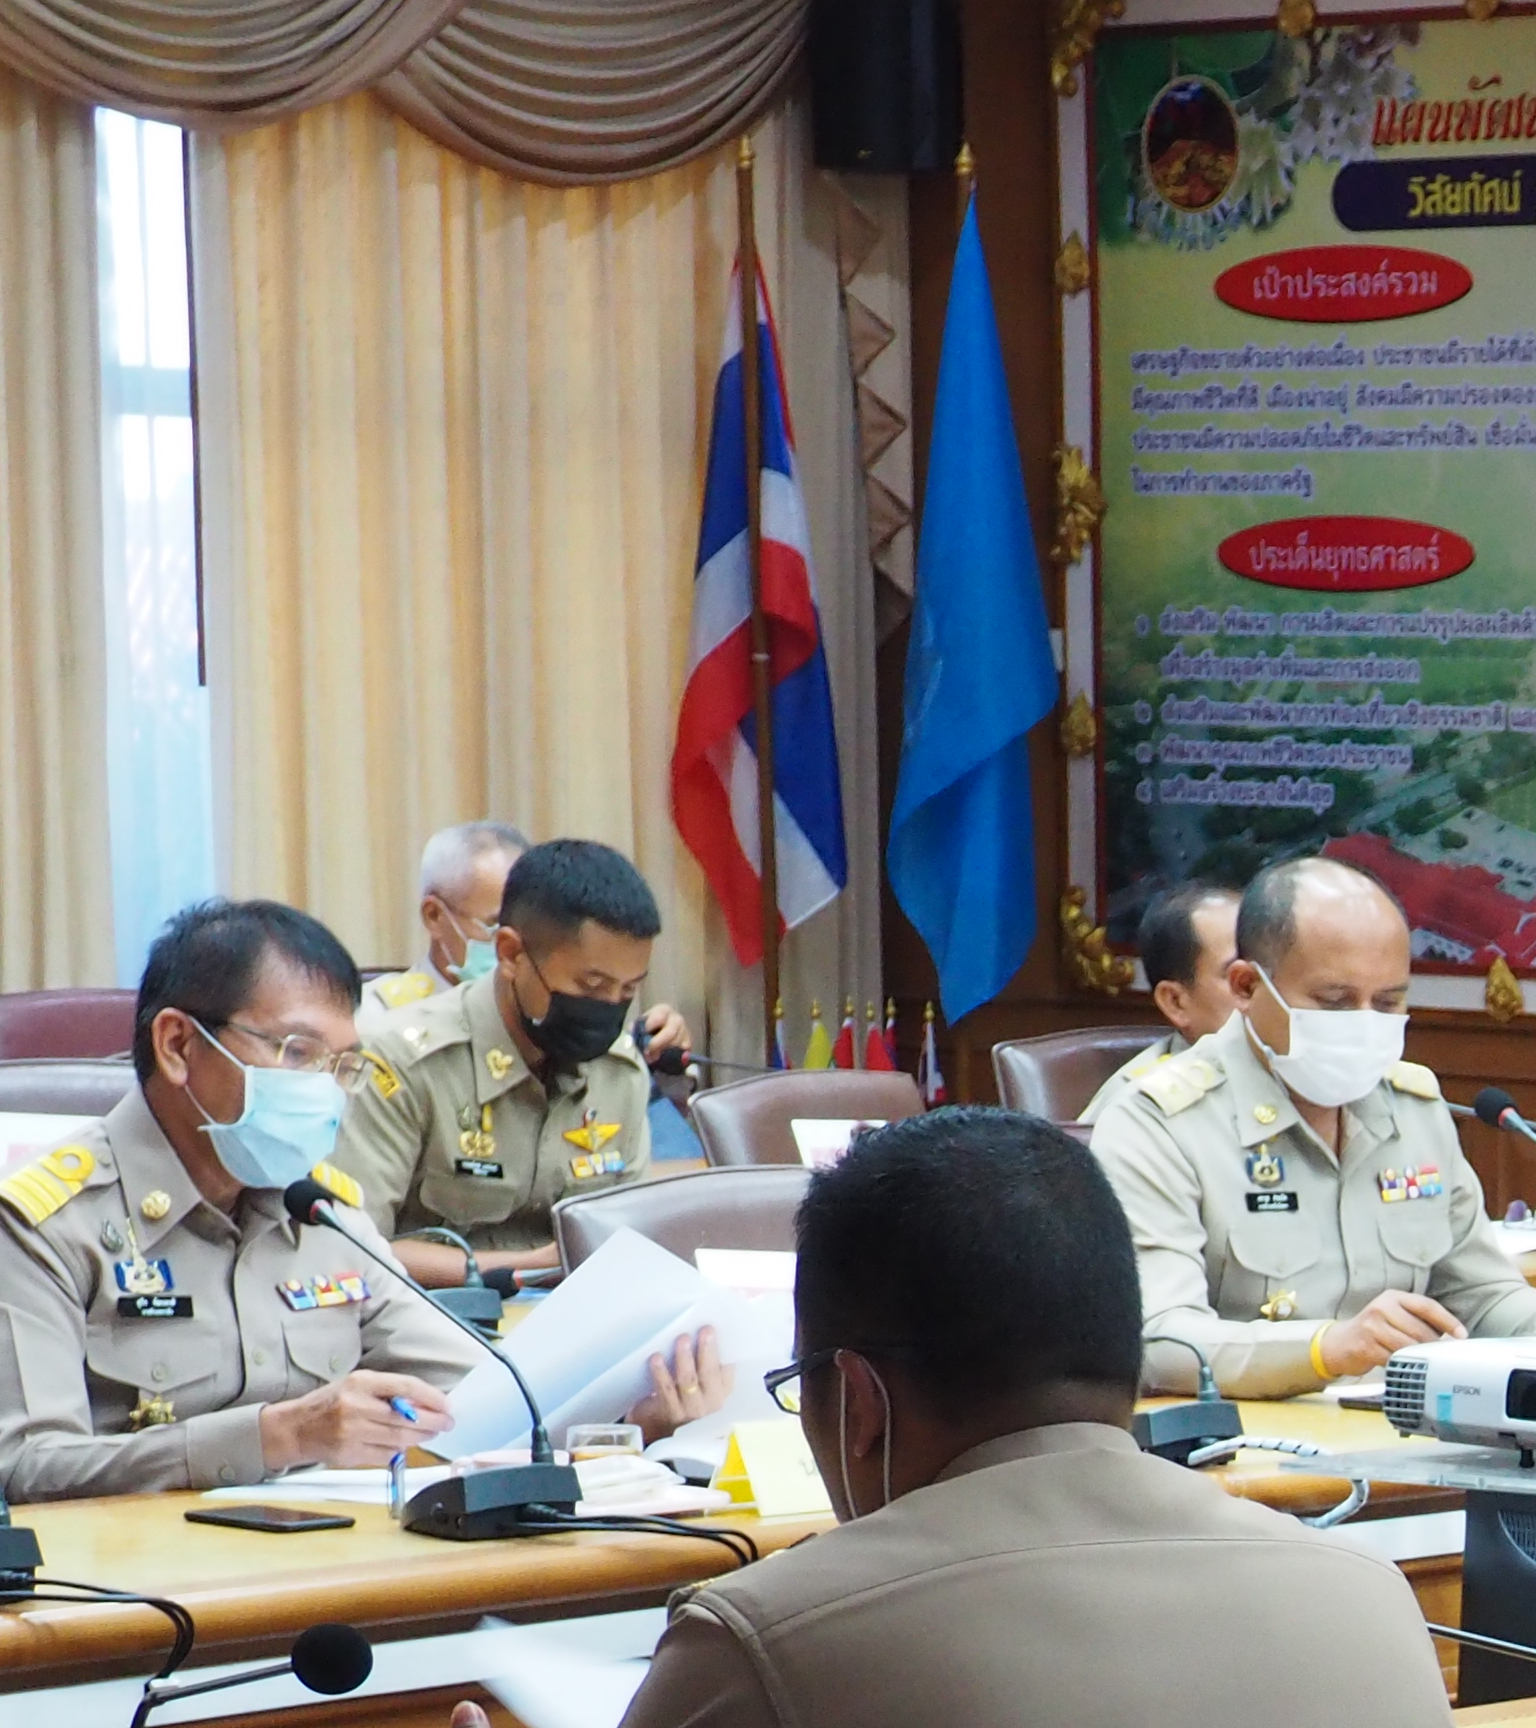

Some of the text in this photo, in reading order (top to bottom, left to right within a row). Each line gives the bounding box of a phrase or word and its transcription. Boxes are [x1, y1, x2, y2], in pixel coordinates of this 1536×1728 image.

[1407, 169, 1524, 217] วิสัยทัศน์
[1253, 258, 1437, 299] เป้าประสงค์รวม
[1250, 531, 1441, 581] ประเด็นยุทธศาสตร์
[1453, 1385, 1481, 1395] EPSON
